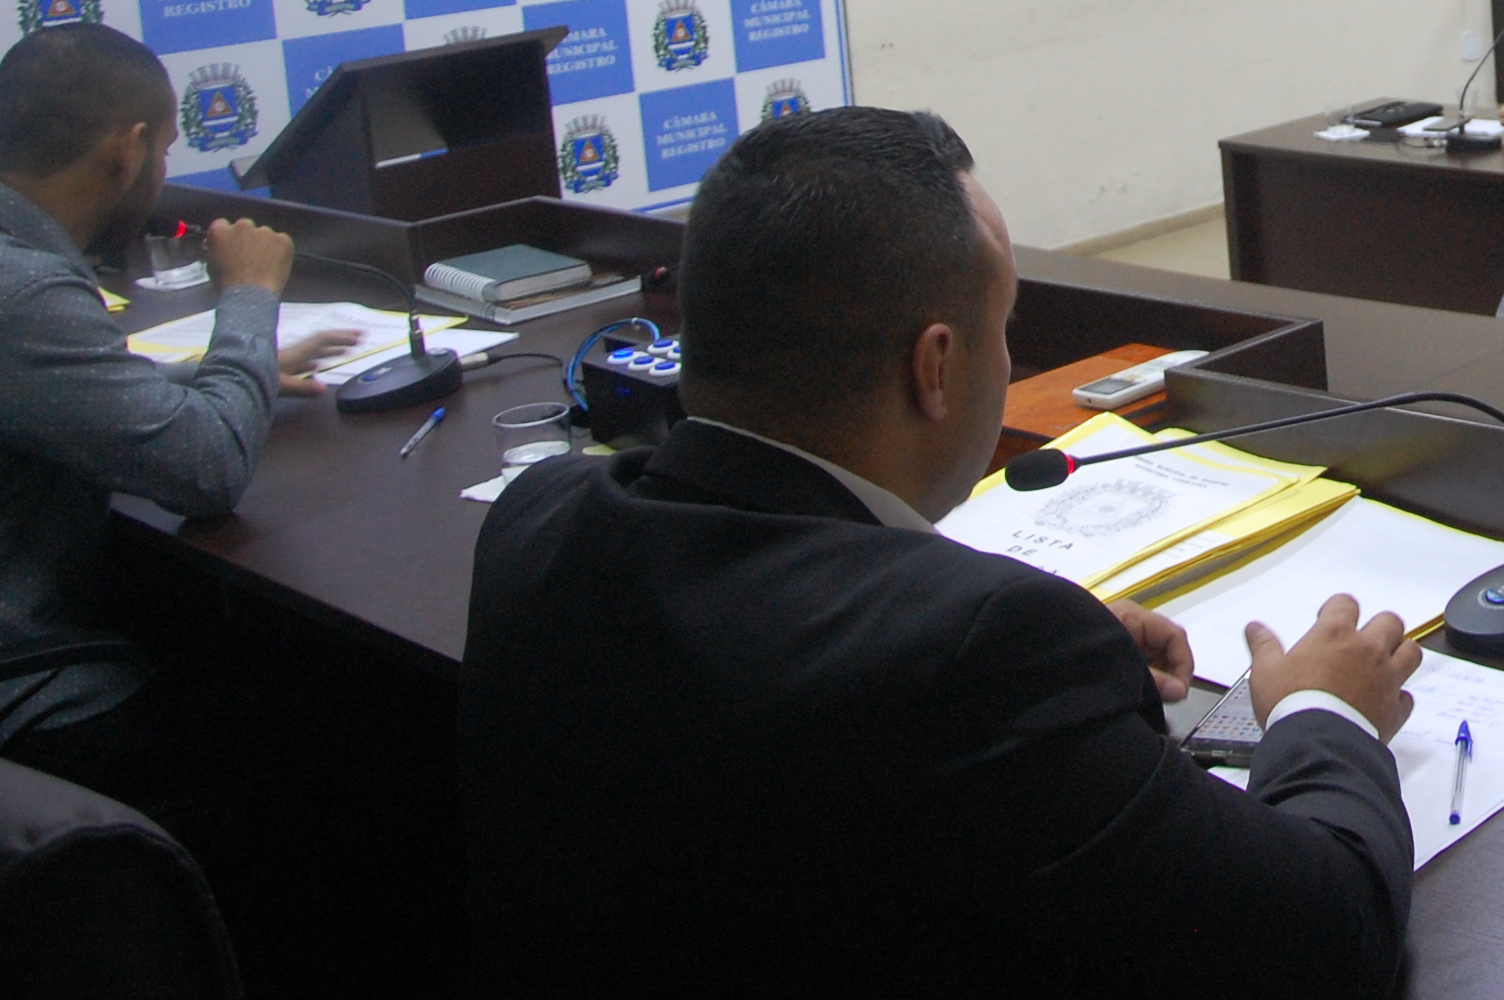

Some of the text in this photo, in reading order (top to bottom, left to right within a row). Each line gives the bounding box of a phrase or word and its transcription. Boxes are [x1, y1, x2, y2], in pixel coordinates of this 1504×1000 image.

[744, 9, 810, 28] MUNICIPAL
[561, 27, 606, 44] MARA
[748, 23, 809, 41] REGISTRO
[663, 111, 717, 130] CÂMARA
[656, 123, 726, 146] MUNICIPAL
[661, 137, 725, 159] REGISTRO
[1012, 529, 1074, 550] LISTA
[1006, 544, 1038, 556] DE
